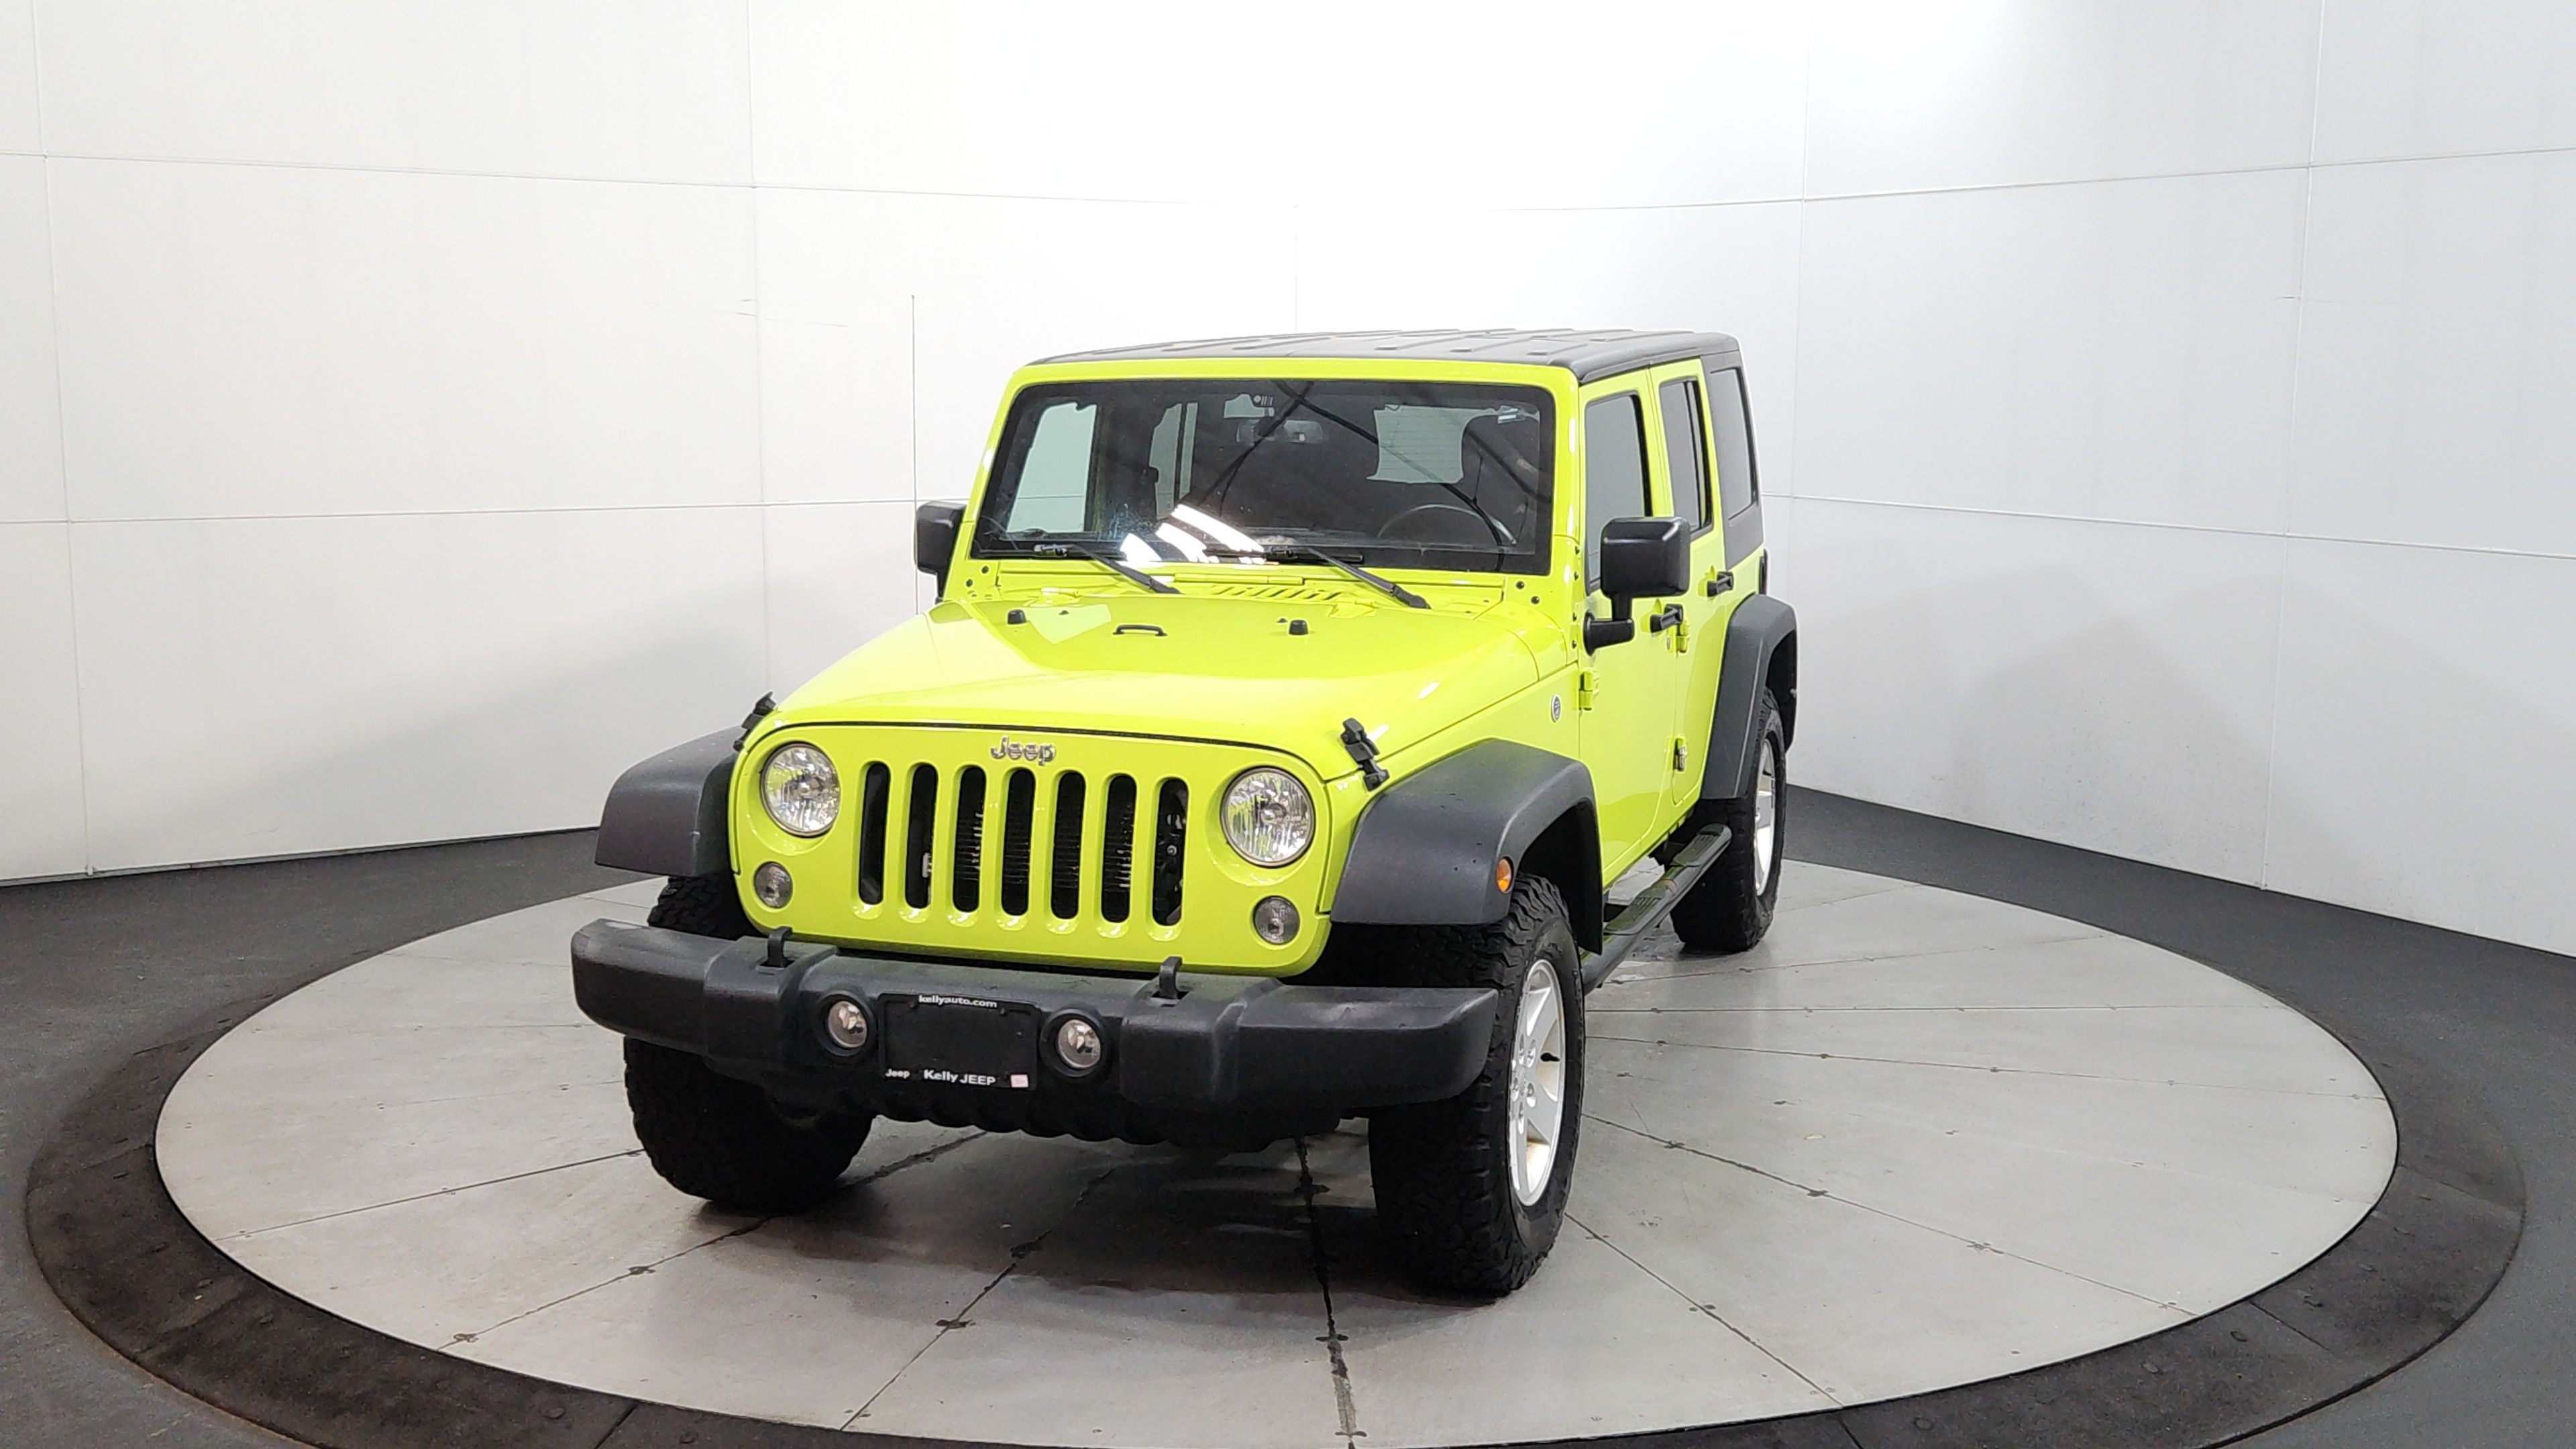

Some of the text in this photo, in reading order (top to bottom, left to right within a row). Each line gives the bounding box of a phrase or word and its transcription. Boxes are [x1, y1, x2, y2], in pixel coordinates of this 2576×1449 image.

[990, 736, 1056, 766] Jeep
[918, 994, 998, 1008] kellyauto.com
[885, 1068, 910, 1079] Jeep
[923, 1069, 996, 1085] Kelly JEEP
